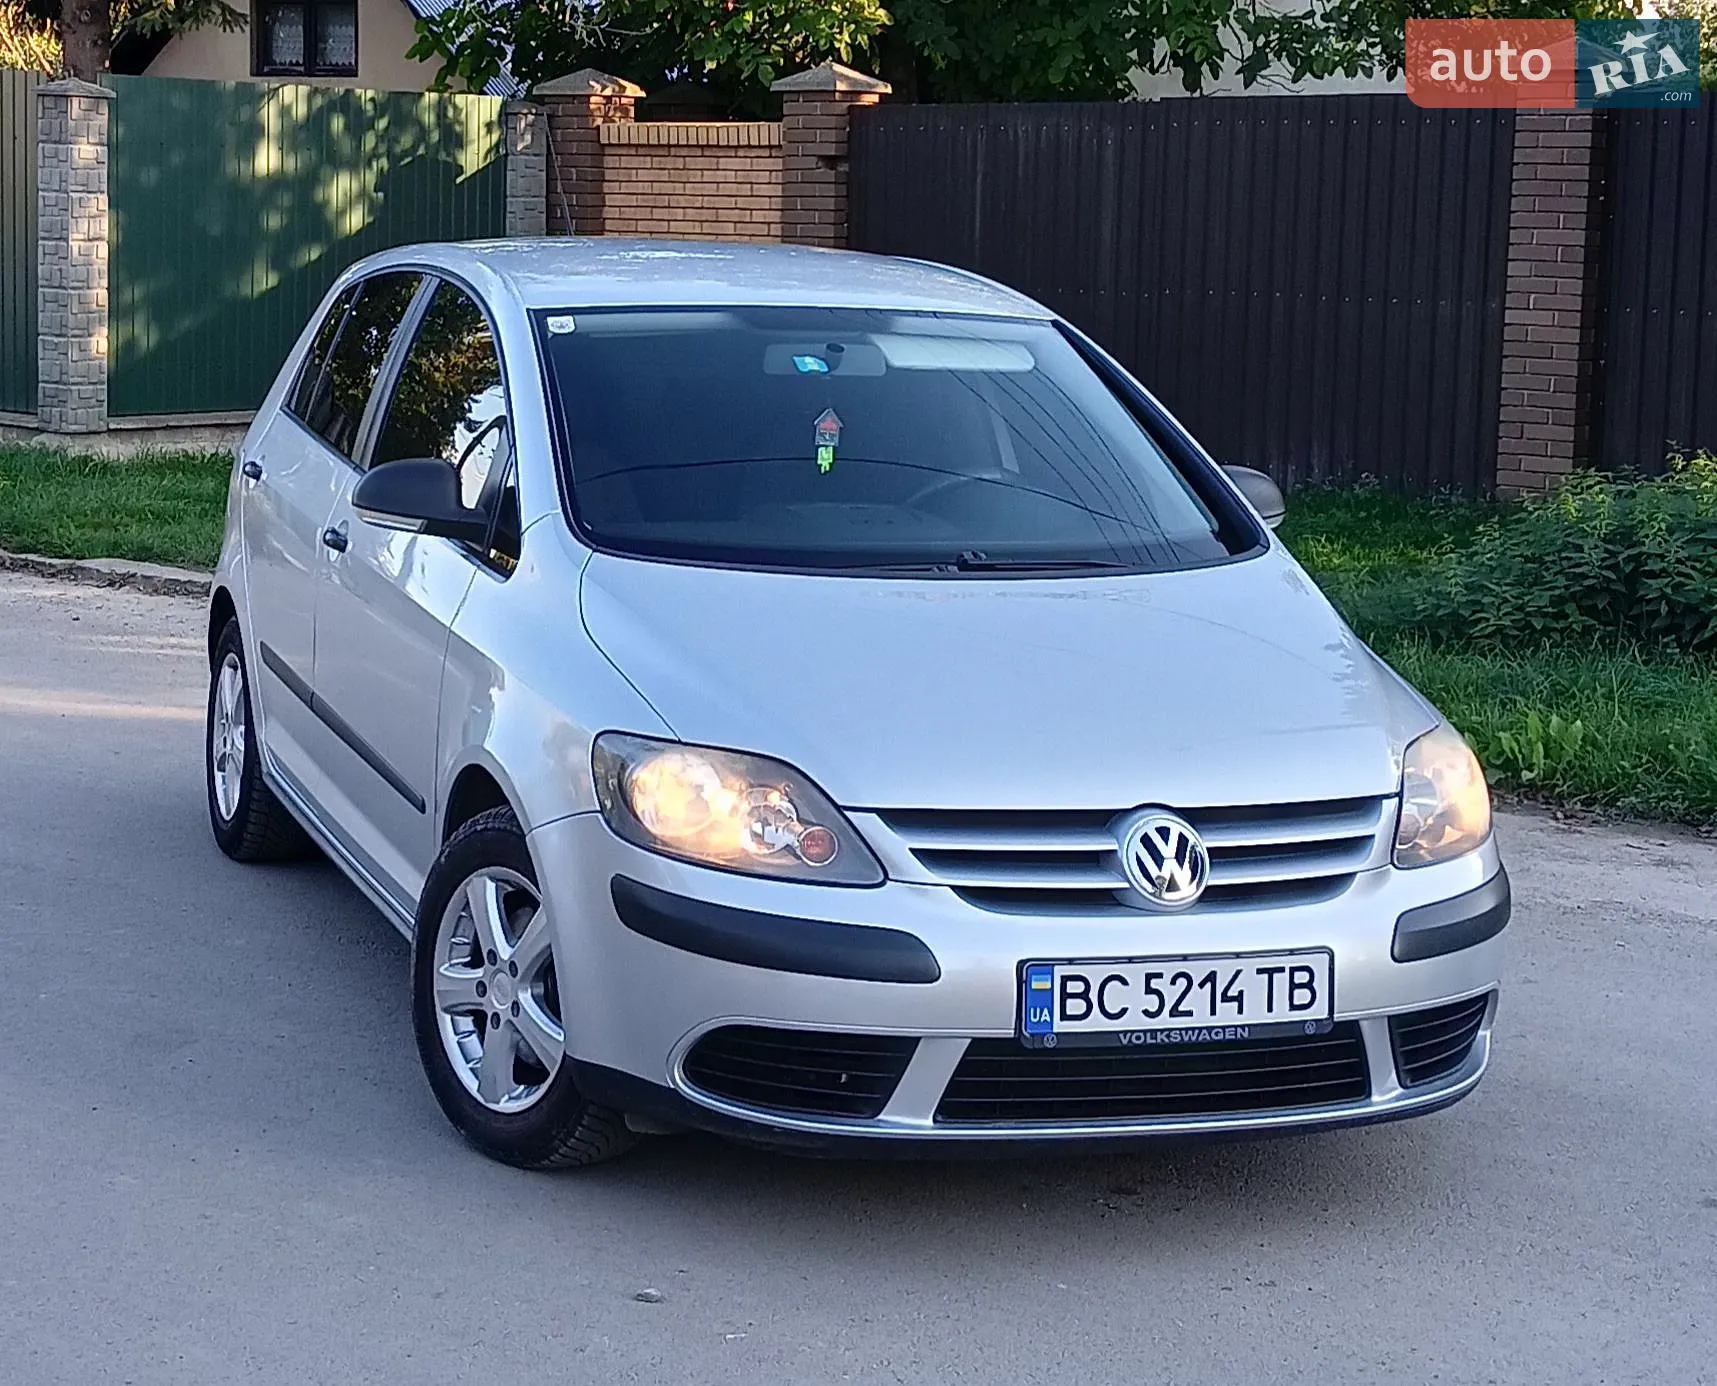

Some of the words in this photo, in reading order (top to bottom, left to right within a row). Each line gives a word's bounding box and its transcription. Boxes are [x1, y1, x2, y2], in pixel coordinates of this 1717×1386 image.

[1059, 974, 1130, 1022] BC
[1141, 969, 1244, 1018] 5214
[1256, 965, 1317, 1013] TB
[1030, 1008, 1051, 1023] UA
[1119, 1026, 1250, 1045] VOLKSWAGEN
